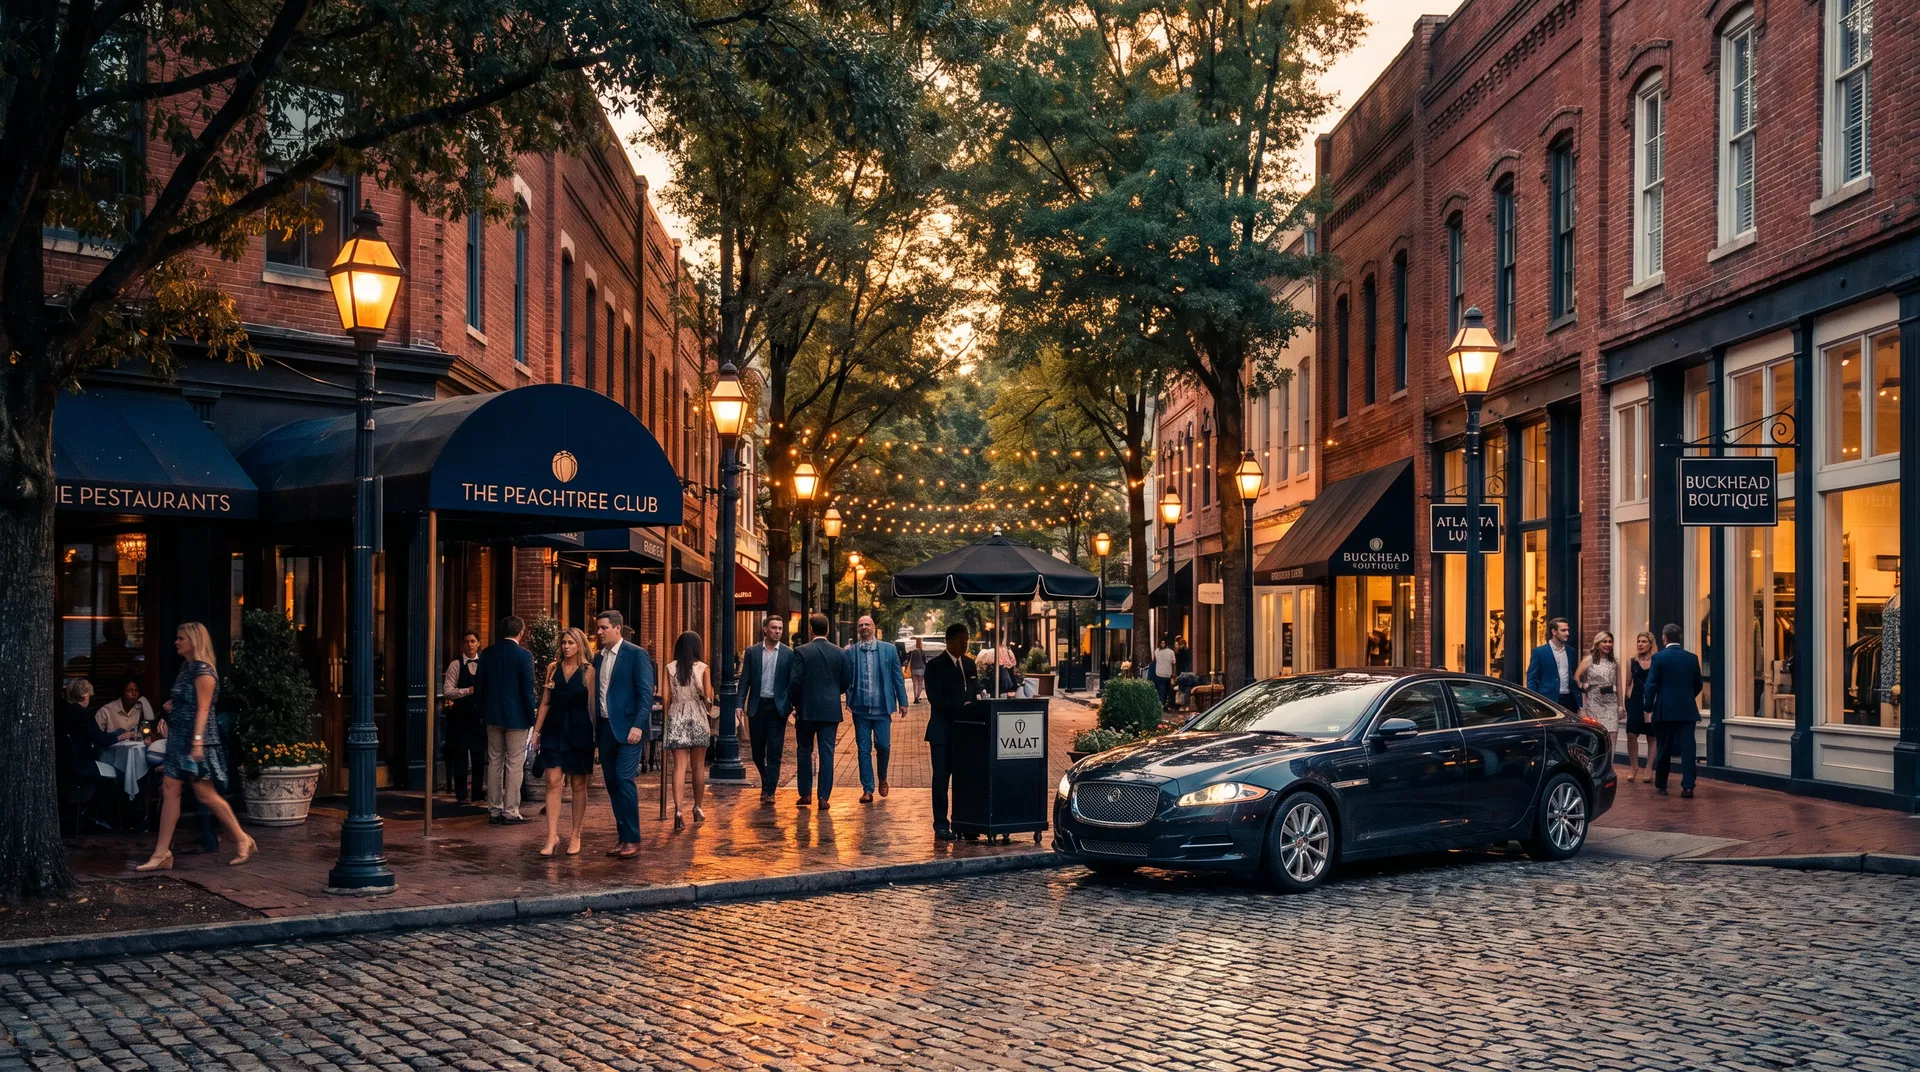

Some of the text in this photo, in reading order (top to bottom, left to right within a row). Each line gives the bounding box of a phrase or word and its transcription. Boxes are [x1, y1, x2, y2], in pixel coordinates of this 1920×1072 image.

[1685, 475, 1771, 490] BUCKHEAD
[55, 486, 231, 512] E PESTAURANTS
[461, 483, 658, 513] THE PEACHTREE CLUB
[1688, 493, 1769, 510] BOUTIQUE
[1436, 516, 1494, 528] ATLATA
[1343, 552, 1410, 562] BUCKHEAD
[1352, 562, 1400, 571] BOUTIQUE
[1000, 737, 1039, 749] VALAT
